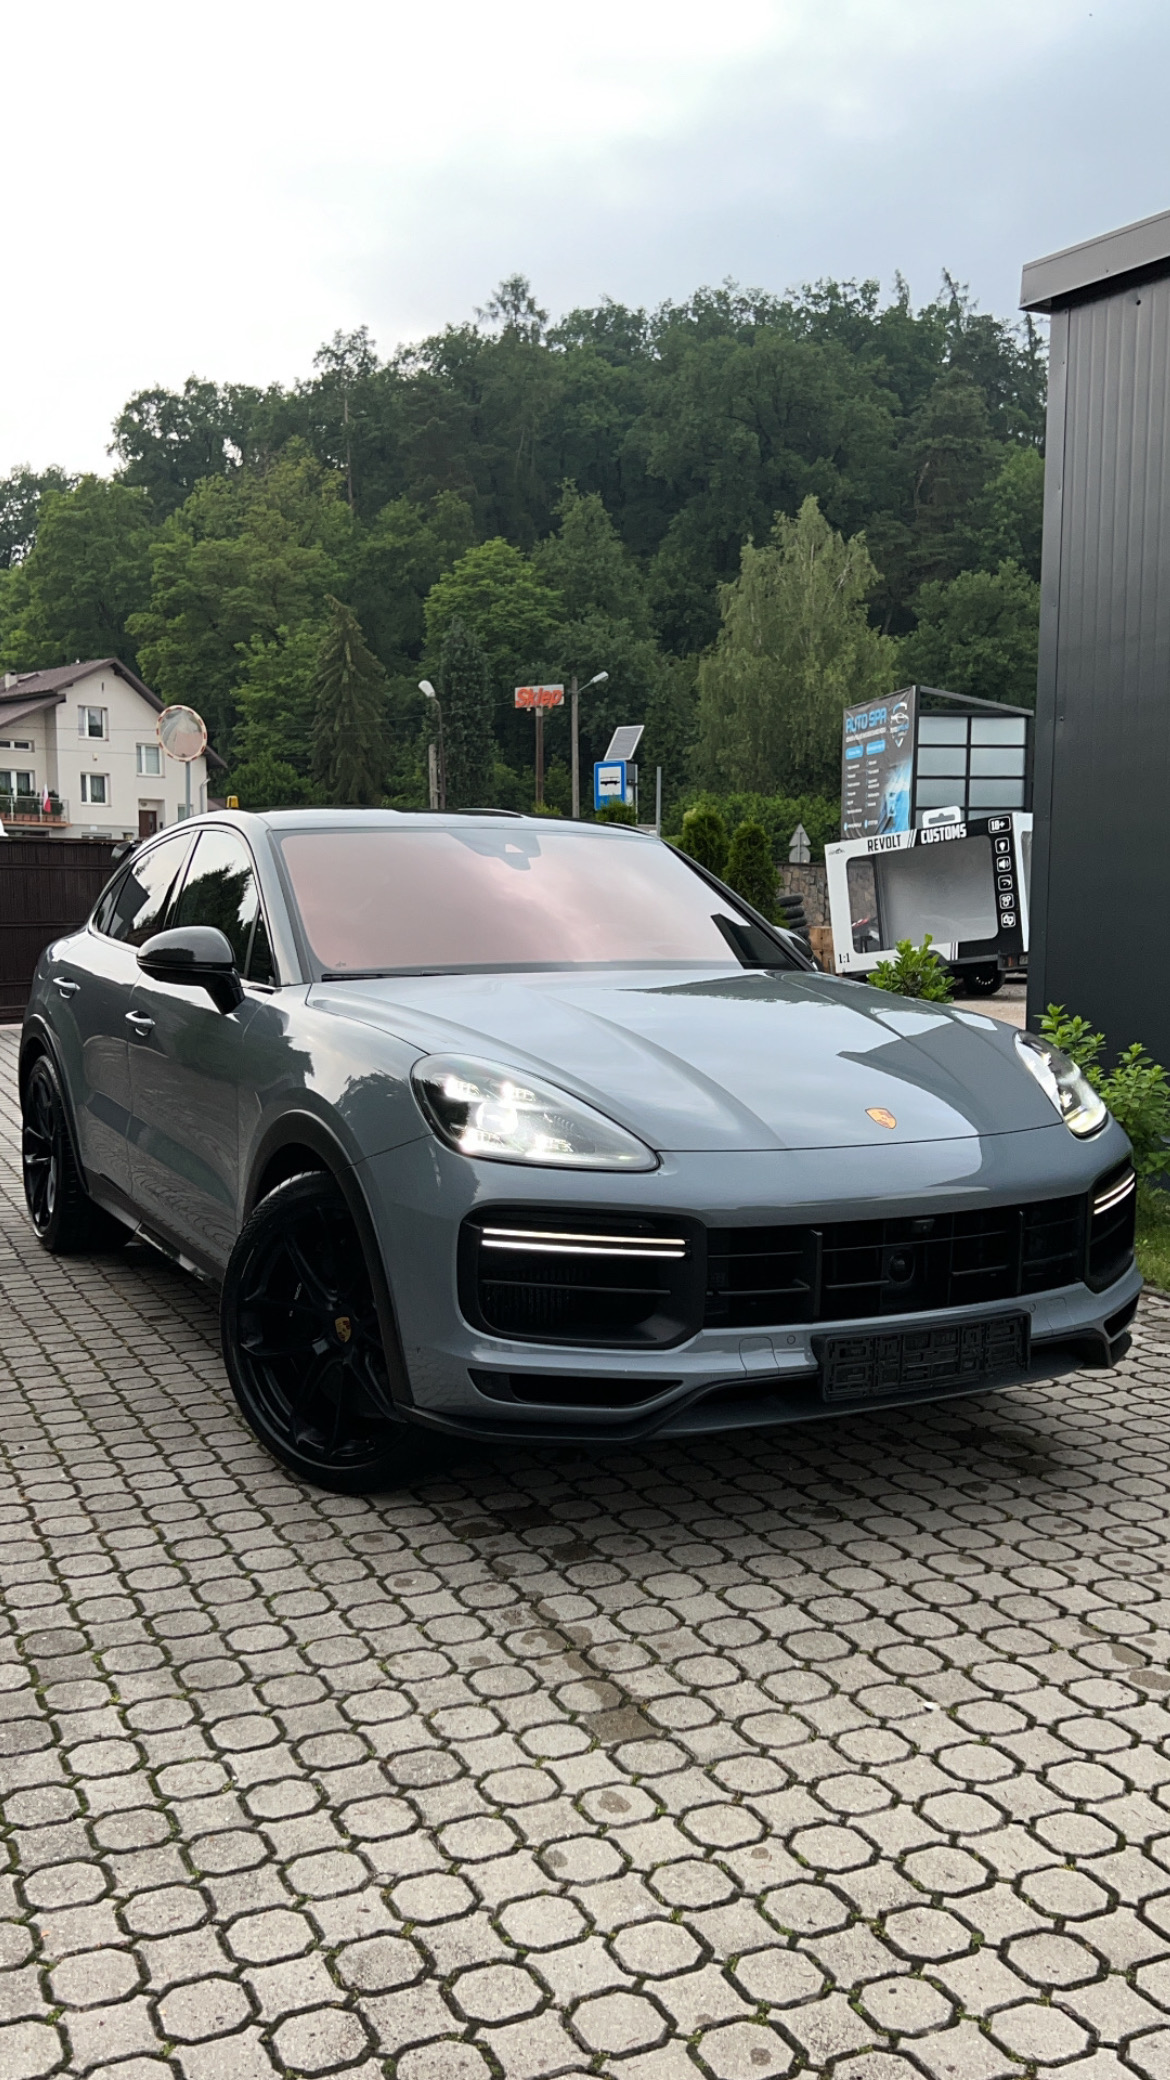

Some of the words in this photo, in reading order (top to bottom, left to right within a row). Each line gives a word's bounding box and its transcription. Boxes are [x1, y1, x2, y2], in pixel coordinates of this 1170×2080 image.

[515, 687, 562, 708] Sklep
[845, 713, 868, 734] AUTO
[868, 707, 887, 728] SPA
[867, 834, 901, 853] REVOLT
[920, 823, 967, 845] CUSTOMS
[838, 952, 850, 964] 1:1
